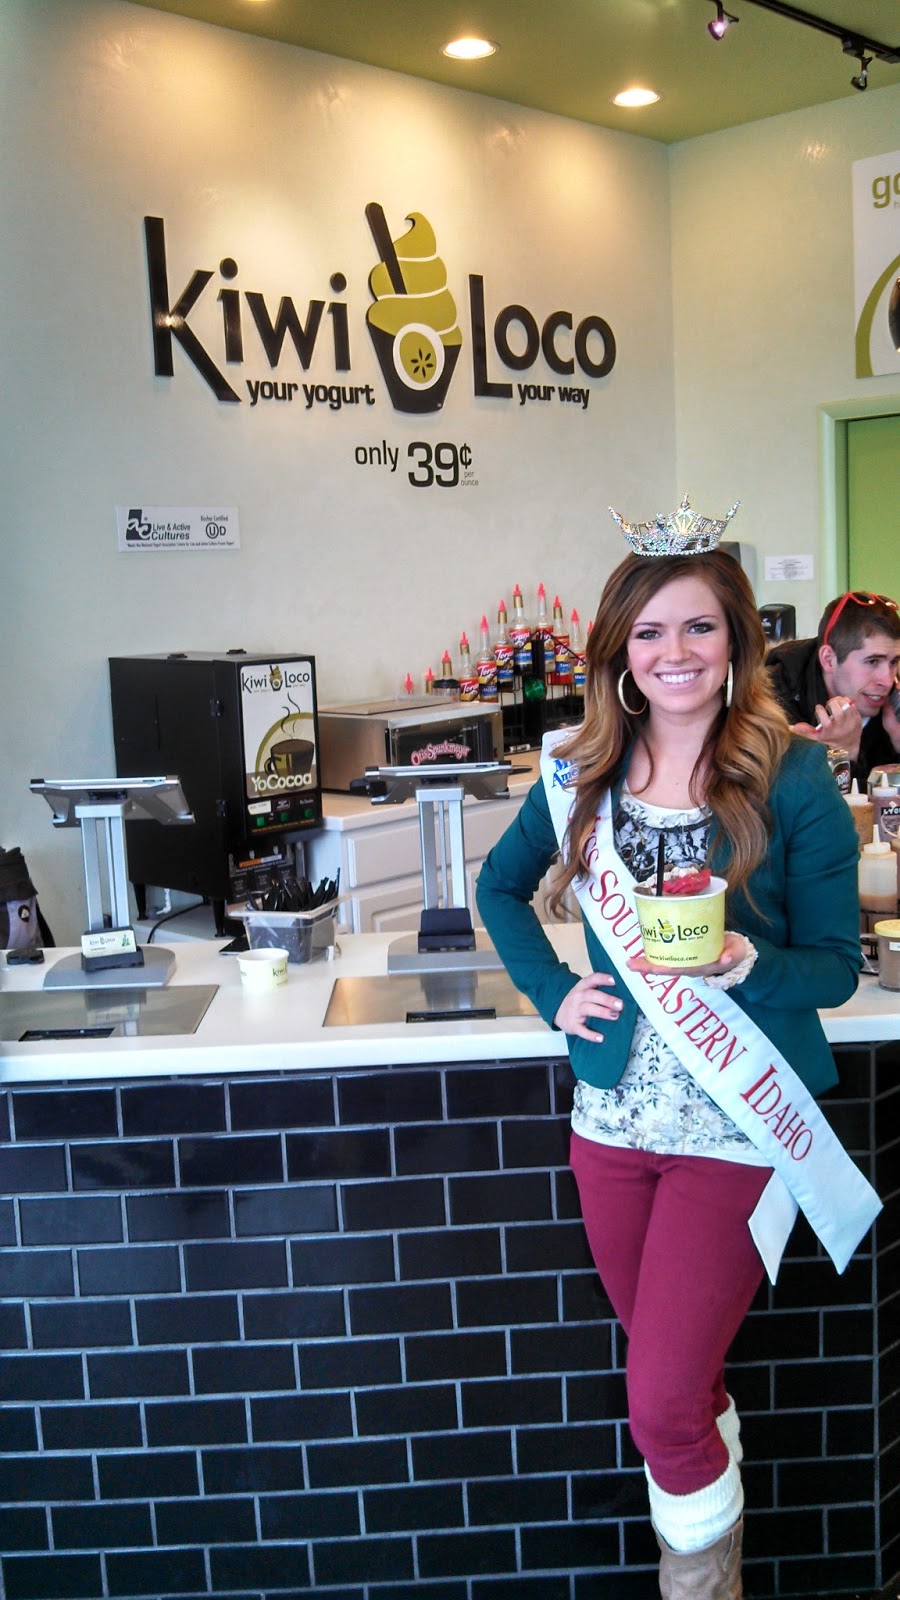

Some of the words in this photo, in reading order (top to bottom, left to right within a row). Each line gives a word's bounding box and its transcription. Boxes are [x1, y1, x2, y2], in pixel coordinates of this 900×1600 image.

[246, 380, 298, 406] your
[302, 384, 376, 410] yogurt
[518, 383, 555, 405] your
[558, 386, 590, 409] way
[355, 440, 399, 472] only
[151, 531, 190, 541] Cultures
[152, 523, 166, 531] Live
[167, 523, 172, 531] &
[172, 523, 191, 531] Active
[252, 773, 312, 793] YoCocoa
